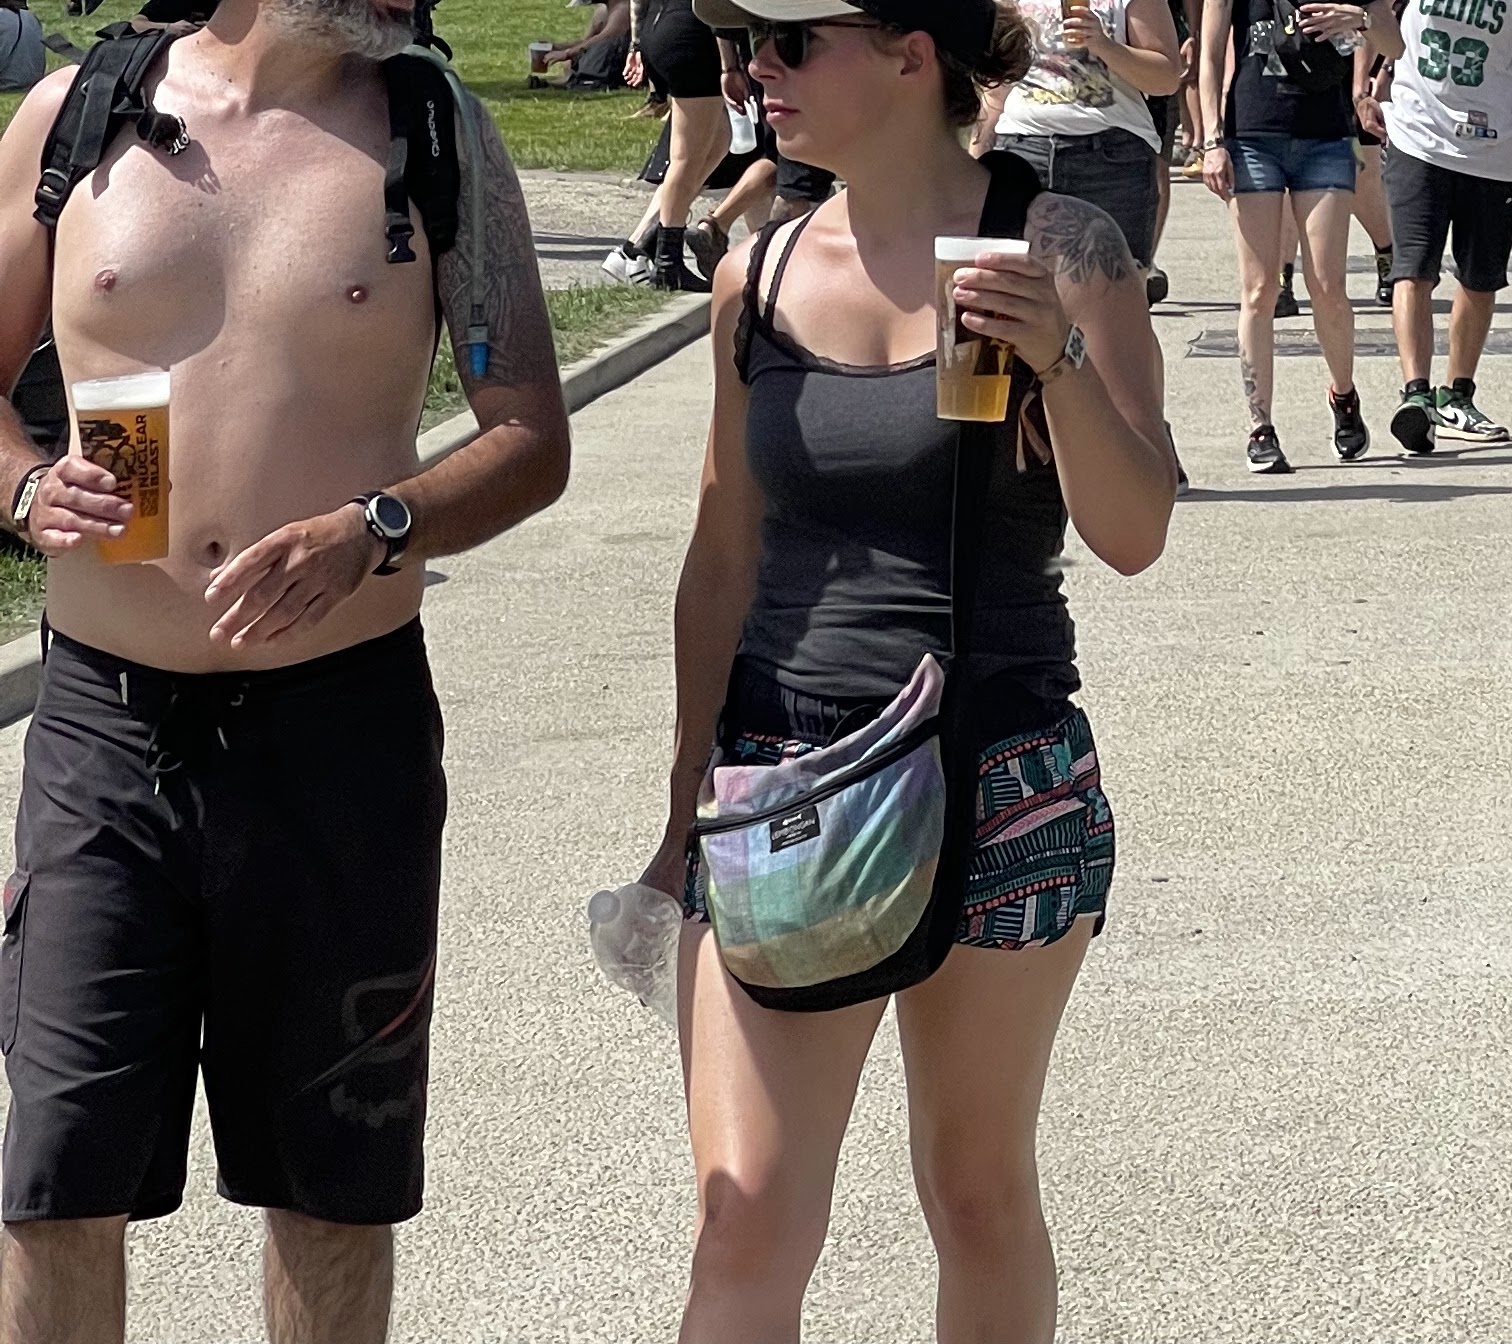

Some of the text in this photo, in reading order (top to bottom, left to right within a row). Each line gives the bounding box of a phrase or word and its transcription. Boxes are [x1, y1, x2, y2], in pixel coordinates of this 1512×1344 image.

[1417, 27, 1490, 88] 33
[426, 100, 441, 157] Quechua
[136, 415, 148, 489] NUCLEAR
[149, 438, 160, 486] BLAST
